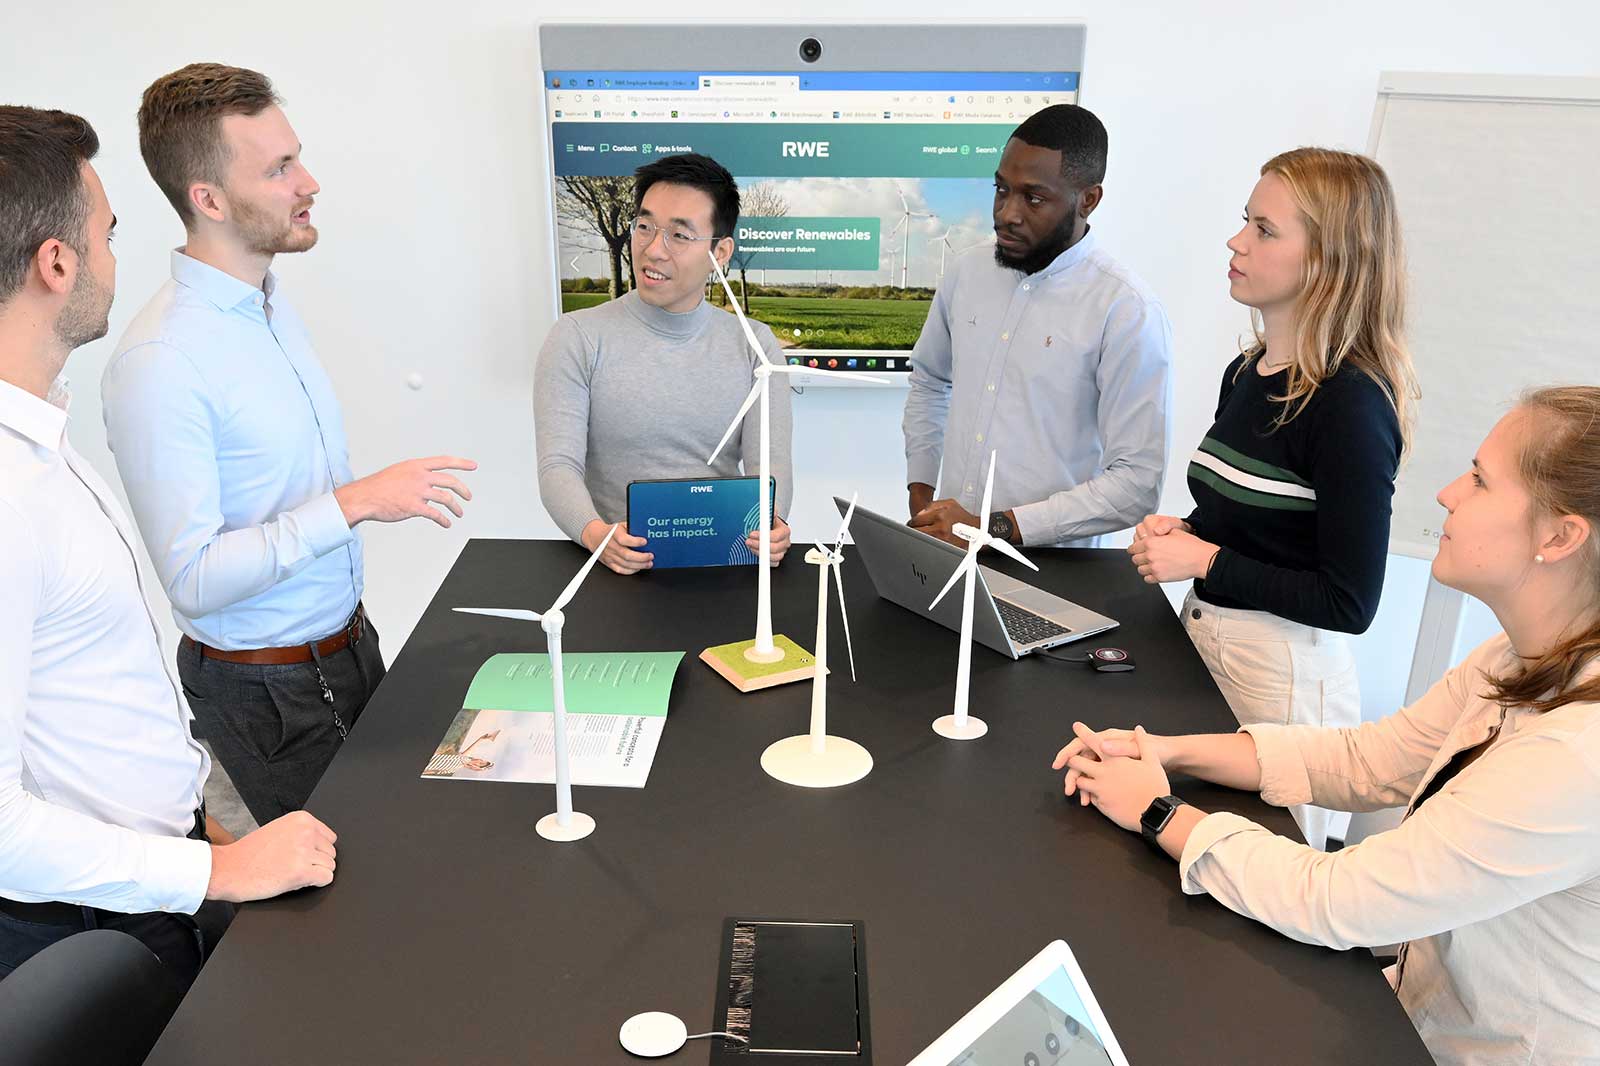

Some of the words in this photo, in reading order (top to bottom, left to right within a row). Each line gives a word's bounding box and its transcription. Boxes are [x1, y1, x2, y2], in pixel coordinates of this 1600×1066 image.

[577, 143, 595, 154] Menu
[612, 143, 637, 154] Contact
[655, 145, 670, 155] Apps
[671, 144, 677, 153] &
[676, 143, 692, 153] tools
[782, 141, 830, 158] RWE
[938, 145, 958, 154] global
[976, 146, 998, 154] Search
[739, 228, 793, 240] Discover
[796, 228, 871, 240] Renewables
[738, 245, 774, 253] Renewables
[797, 245, 816, 253] future
[647, 517, 670, 526] Our
[672, 517, 714, 526] energy
[647, 529, 670, 539] has
[672, 527, 718, 539] impact.
